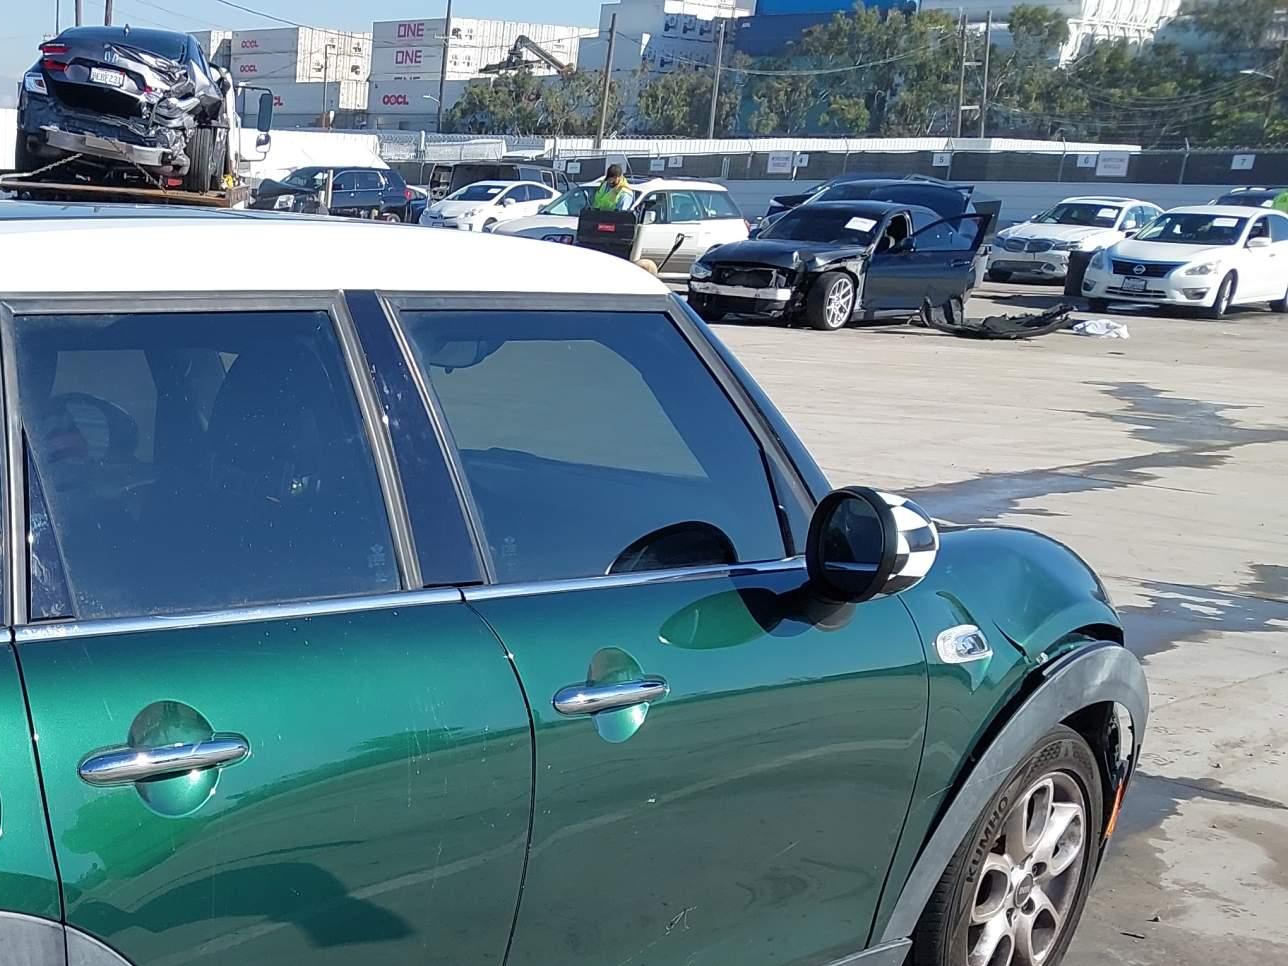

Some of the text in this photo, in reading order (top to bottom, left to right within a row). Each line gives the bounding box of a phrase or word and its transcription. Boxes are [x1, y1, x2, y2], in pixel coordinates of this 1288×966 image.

[397, 23, 424, 38] ONE
[395, 50, 422, 65] ONE
[382, 94, 409, 106] OOCL
[965, 796, 1009, 883] KUMHO
